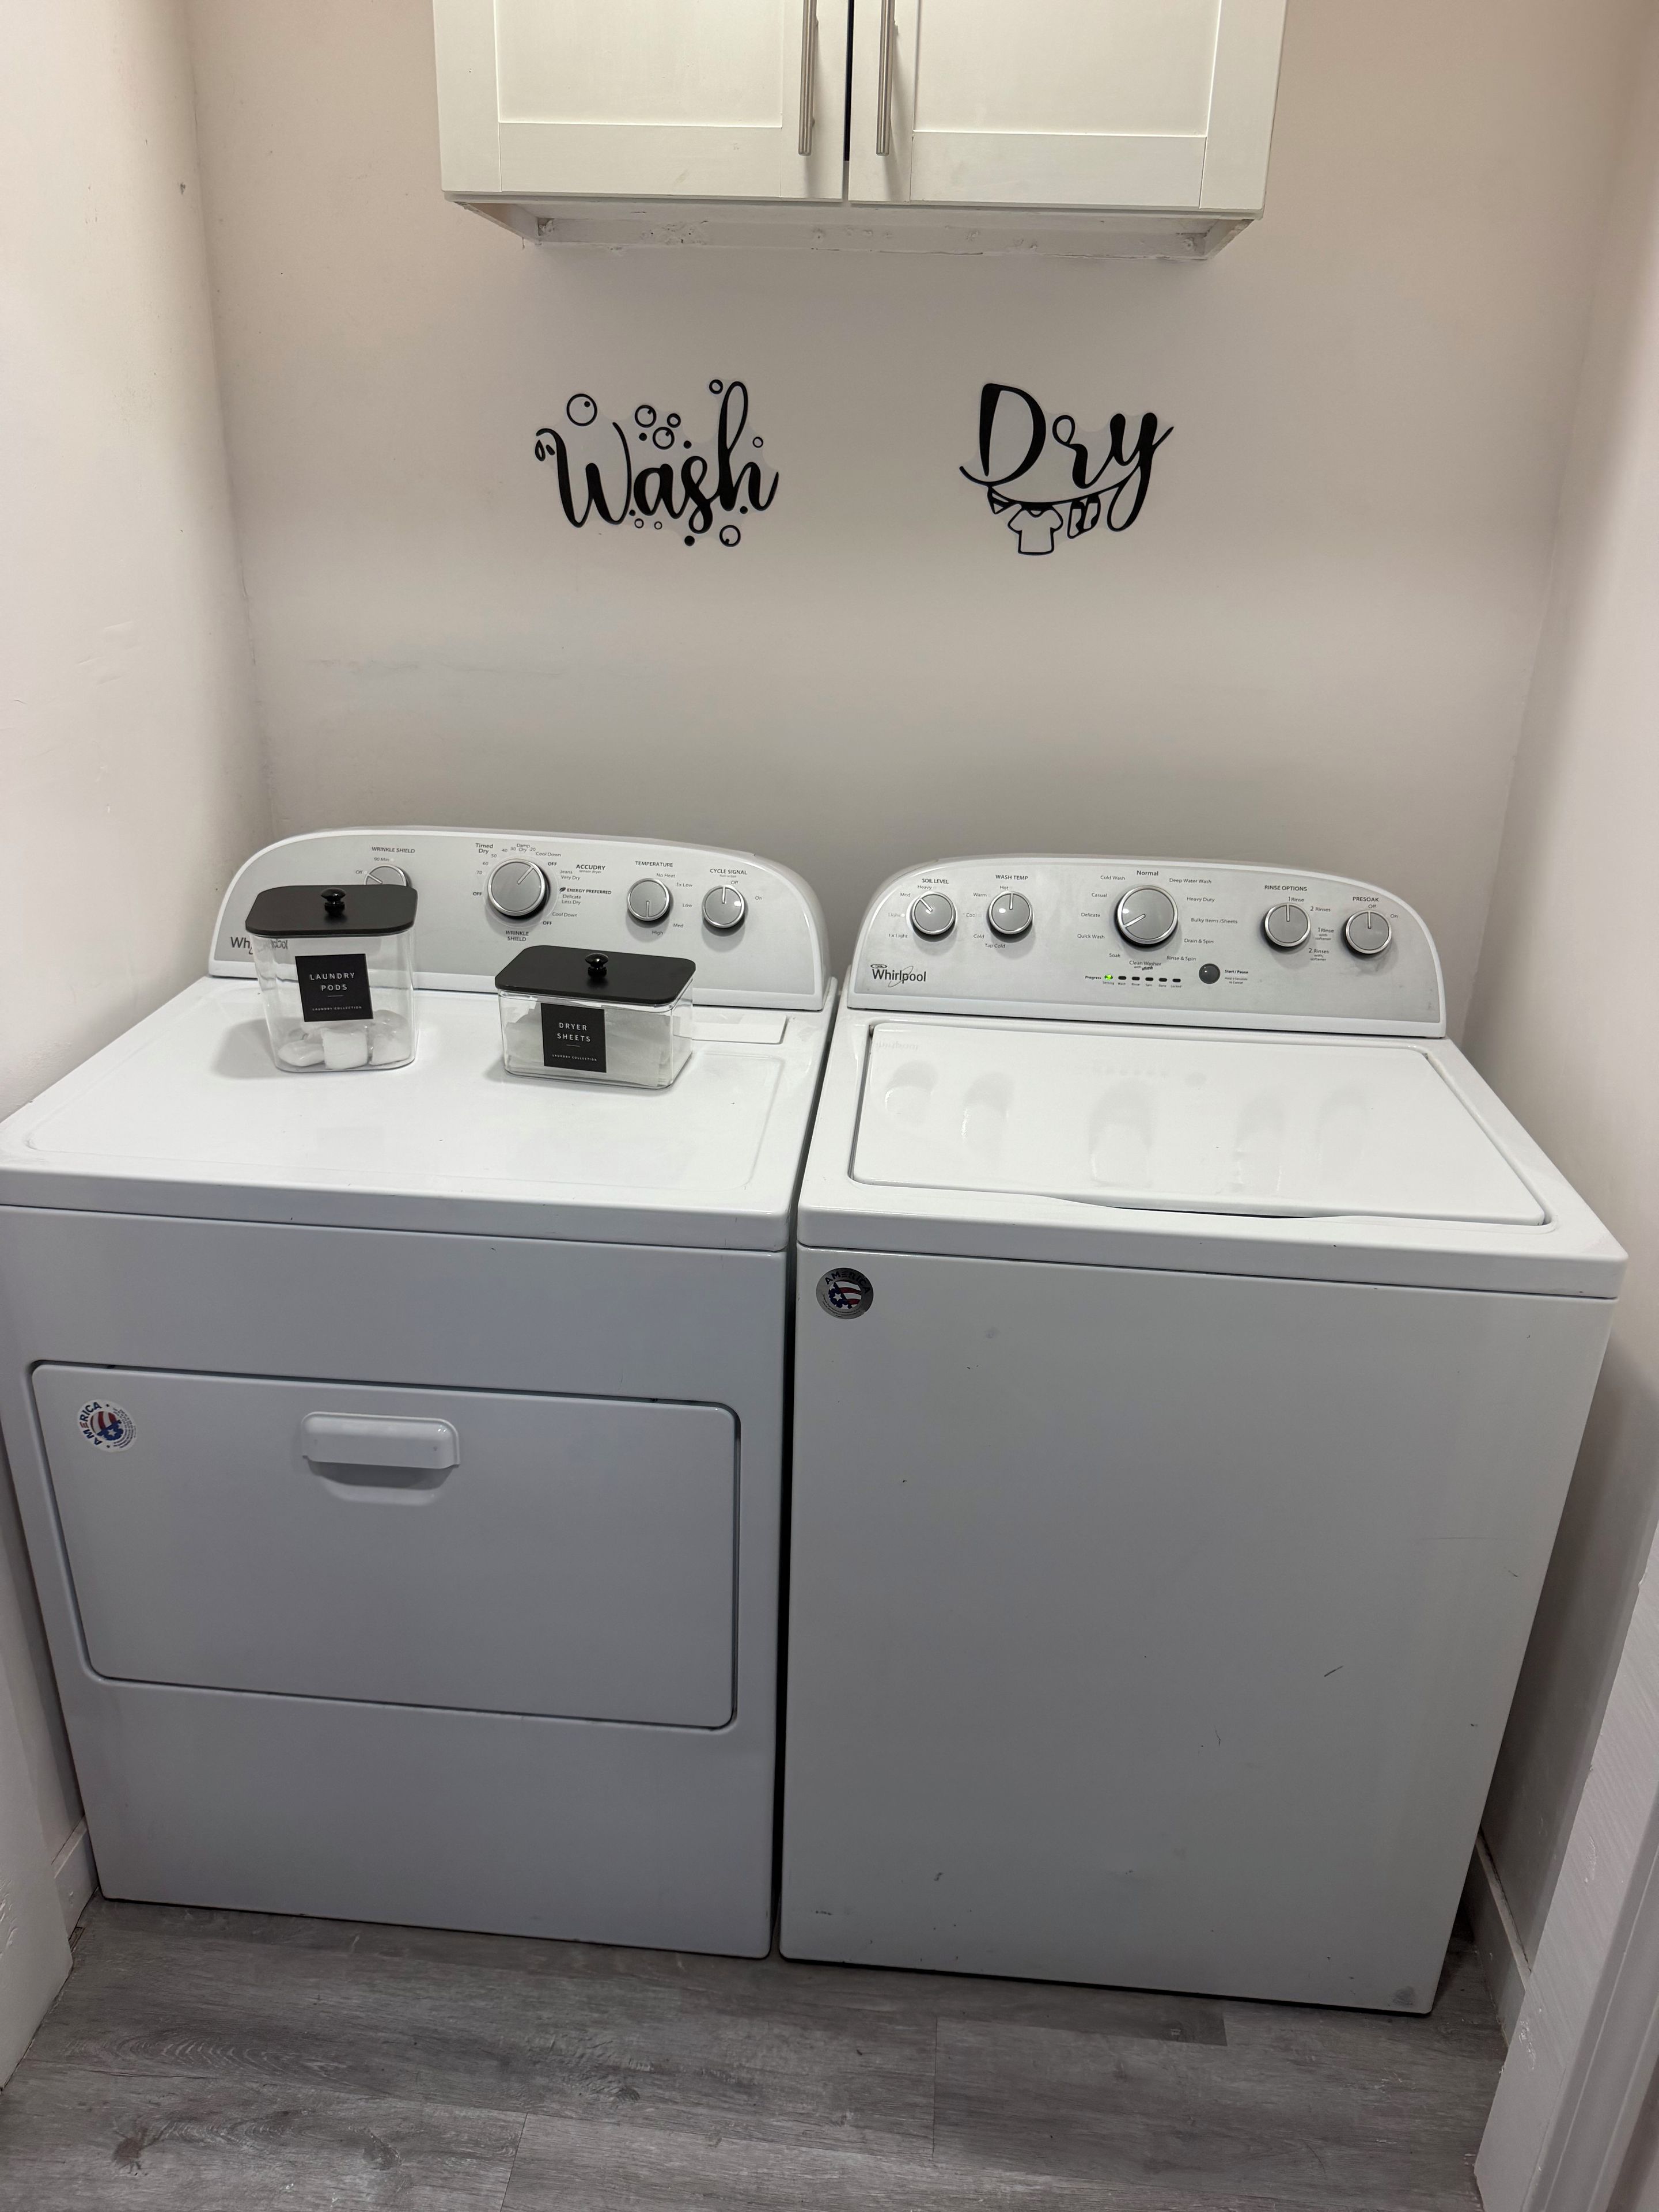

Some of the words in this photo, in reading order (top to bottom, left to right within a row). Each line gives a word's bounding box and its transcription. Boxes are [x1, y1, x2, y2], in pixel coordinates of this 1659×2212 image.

[535, 381, 779, 533] Wash
[959, 383, 1174, 532] Dry
[310, 972, 355, 980] LAUNDRY
[872, 968, 926, 984] Whirlpool
[559, 1022, 587, 1031] DRYER
[557, 1033, 590, 1042] SHEETS
[825, 1271, 871, 1294] AMERICA
[79, 1402, 103, 1445] AMERICA
